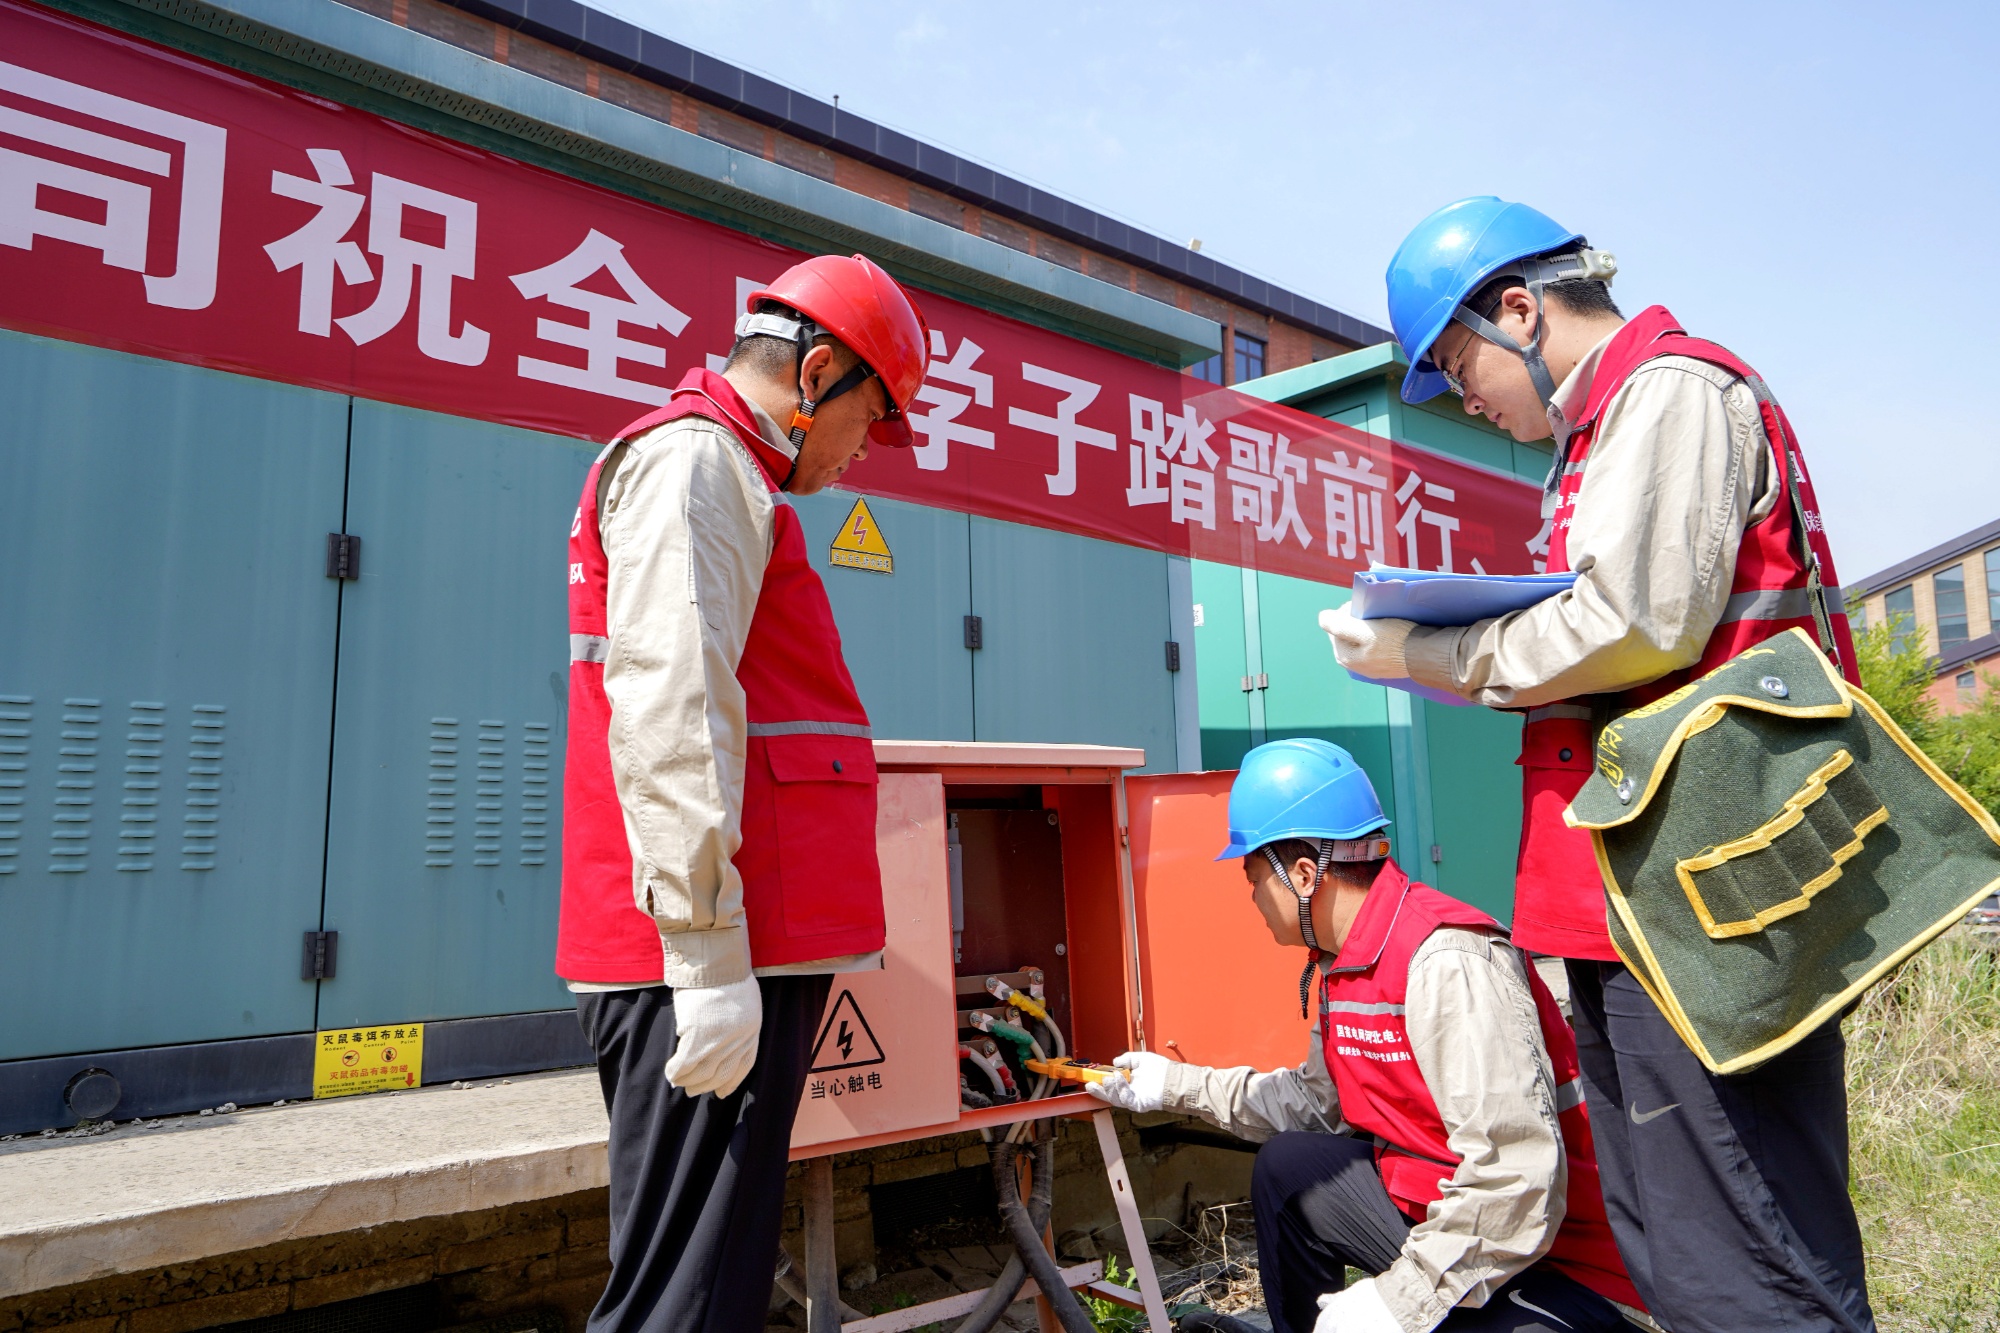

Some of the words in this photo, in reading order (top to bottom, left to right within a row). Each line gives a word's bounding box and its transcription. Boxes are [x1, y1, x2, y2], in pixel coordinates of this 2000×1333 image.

[322, 1028, 419, 1046] 灭鼠毒饵布放点
[811, 1071, 883, 1100] 当心触电
